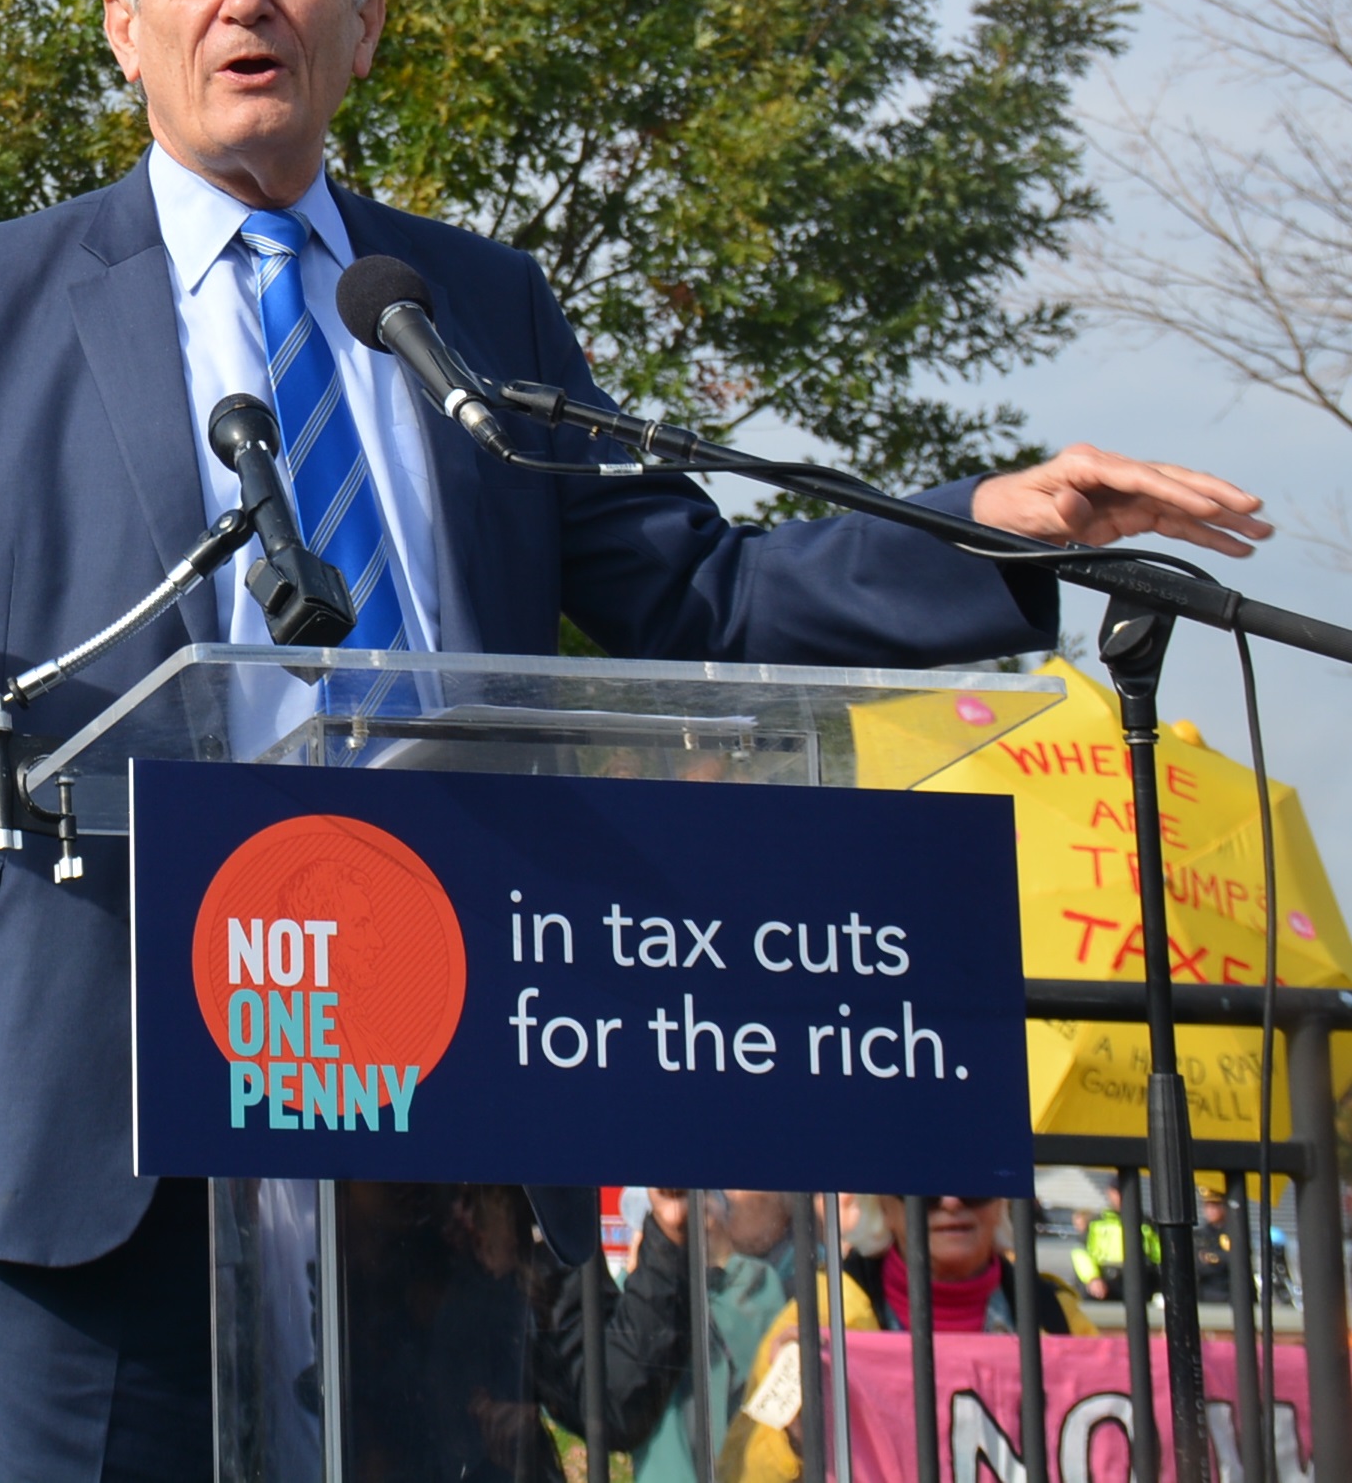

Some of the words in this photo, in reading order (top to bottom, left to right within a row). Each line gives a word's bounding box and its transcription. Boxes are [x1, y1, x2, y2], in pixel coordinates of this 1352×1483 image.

[998, 741, 1199, 803] WHEE
[228, 918, 337, 987] NOT
[510, 890, 573, 963] in
[602, 904, 726, 969] tax
[753, 912, 910, 976] cuts
[1061, 909, 1287, 987] TAXE
[228, 989, 340, 1058] ONE
[508, 987, 622, 1068] for
[648, 993, 776, 1074] the
[808, 1001, 969, 1080] rich.
[230, 1061, 420, 1132] PENNY
